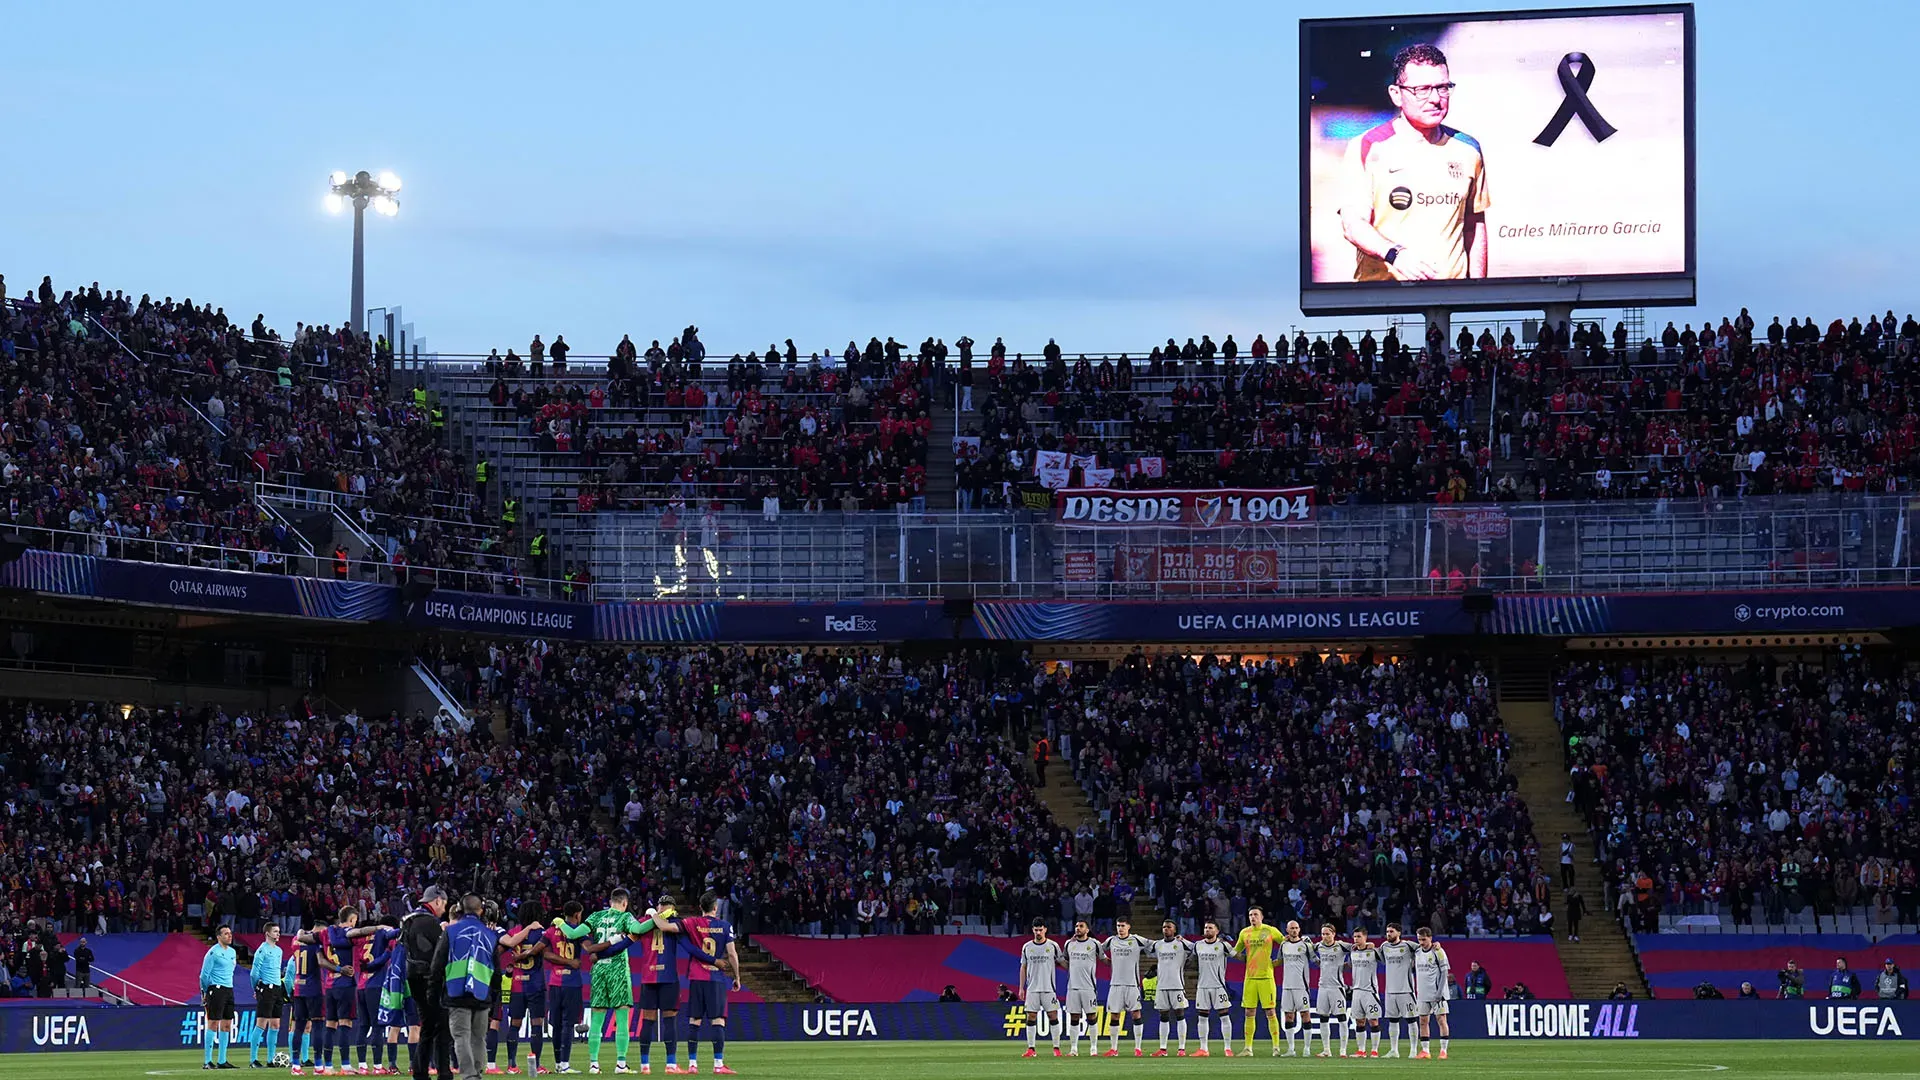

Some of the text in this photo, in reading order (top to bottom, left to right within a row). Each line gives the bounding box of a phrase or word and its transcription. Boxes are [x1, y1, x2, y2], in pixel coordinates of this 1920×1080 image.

[1498, 224, 1544, 238] Carles
[1549, 221, 1608, 236] Miñarro
[1062, 496, 1310, 522] DESDE 1904
[169, 580, 247, 598] QATAR AIRWAYS
[425, 601, 456, 619] UEFA
[530, 612, 573, 629] LEAGUE
[1178, 611, 1420, 629] UEFA CHAMPIONS LEAGUE
[1755, 604, 1844, 619] crypto.com
[825, 615, 876, 631] FedEx
[556, 940, 575, 960] 10
[651, 929, 665, 954] 4
[702, 937, 717, 957] 9
[294, 949, 308, 975] 11
[1177, 994, 1182, 1003] 6
[1218, 994, 1228, 1003] 30
[1302, 996, 1308, 1005] 8
[1368, 1004, 1379, 1013] 26
[33, 1016, 90, 1044] UEFA
[803, 1010, 878, 1036] UEFA
[1485, 1004, 1639, 1036] WELCOME ALL
[1810, 1006, 1902, 1036] UEFA
